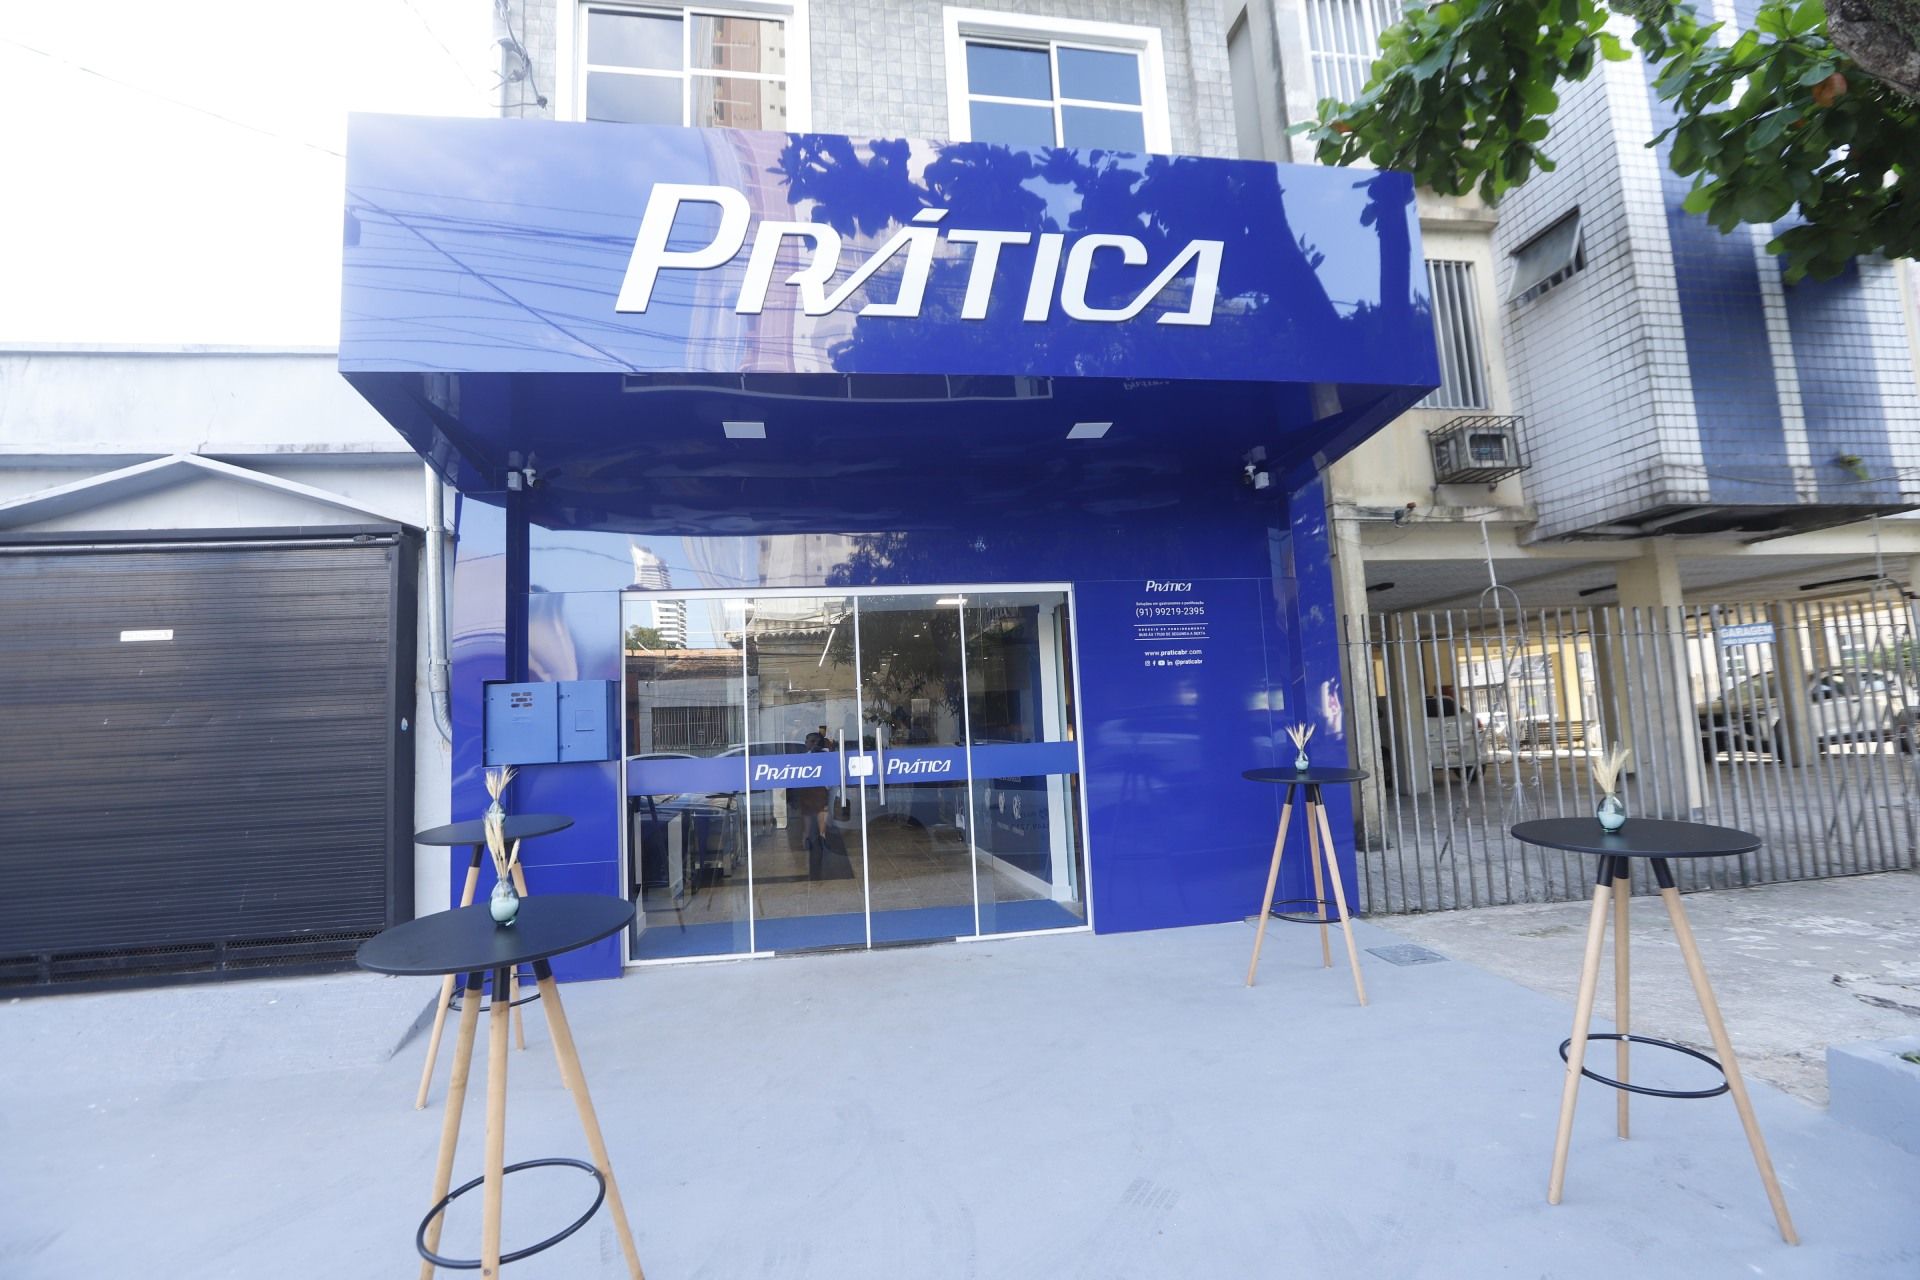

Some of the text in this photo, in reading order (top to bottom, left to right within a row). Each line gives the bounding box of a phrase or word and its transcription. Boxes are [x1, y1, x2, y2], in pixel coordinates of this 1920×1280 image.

[614, 182, 1225, 326] PRÁTICA
[1145, 580, 1192, 592] PRÁTICA
[1135, 606, 1205, 618] (91) 99219-2395
[1144, 649, 1203, 657] www.praticabr.com
[1174, 659, 1203, 667] @praticabr
[754, 764, 823, 781] PRÁTICA
[887, 758, 951, 775] PRÁTICA
